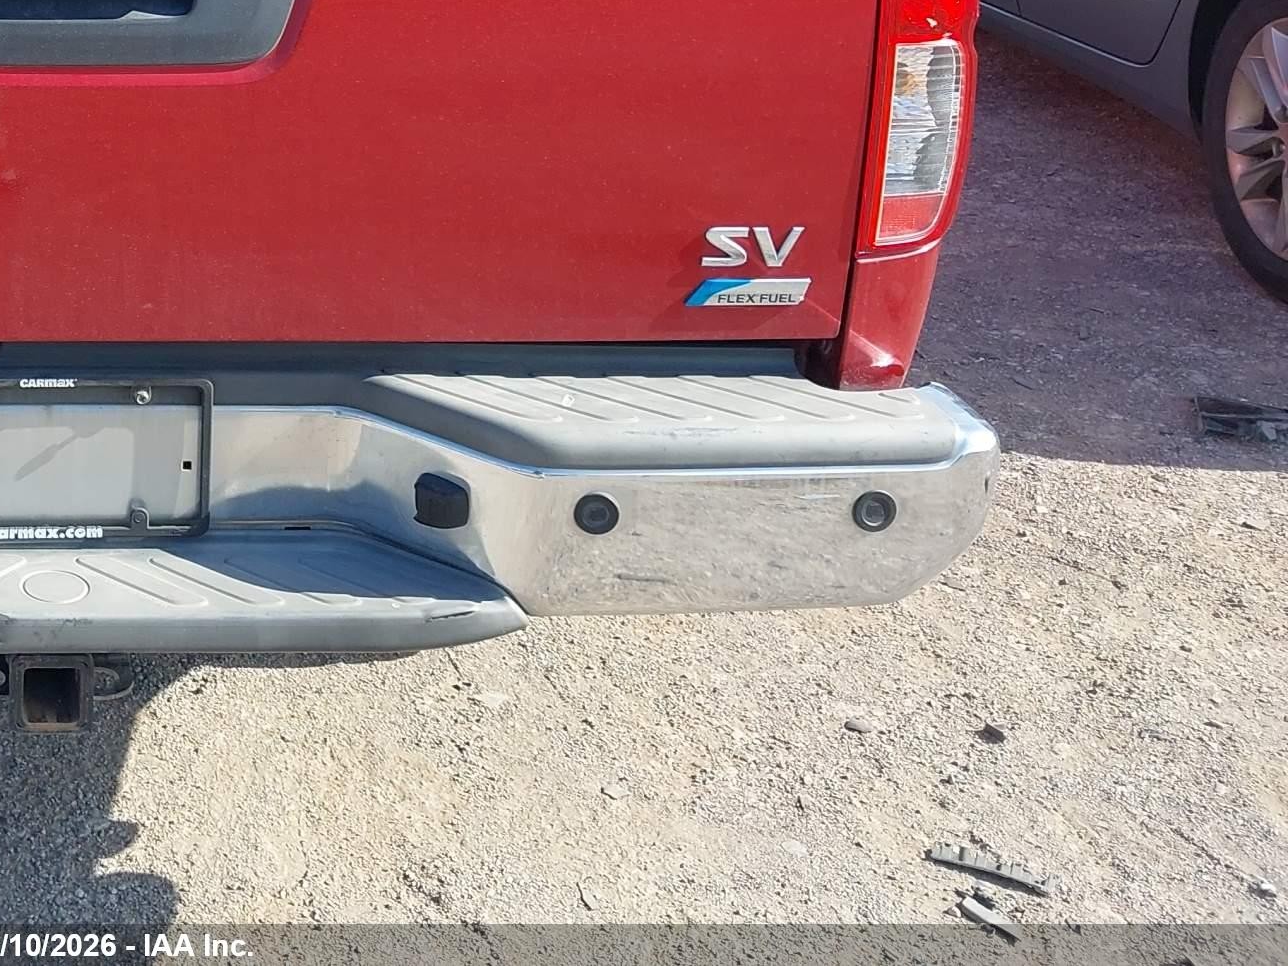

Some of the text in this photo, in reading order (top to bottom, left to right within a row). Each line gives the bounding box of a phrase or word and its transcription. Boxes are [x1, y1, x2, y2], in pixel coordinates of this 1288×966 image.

[700, 226, 806, 267] SV
[717, 293, 796, 304] FLEX FUEL
